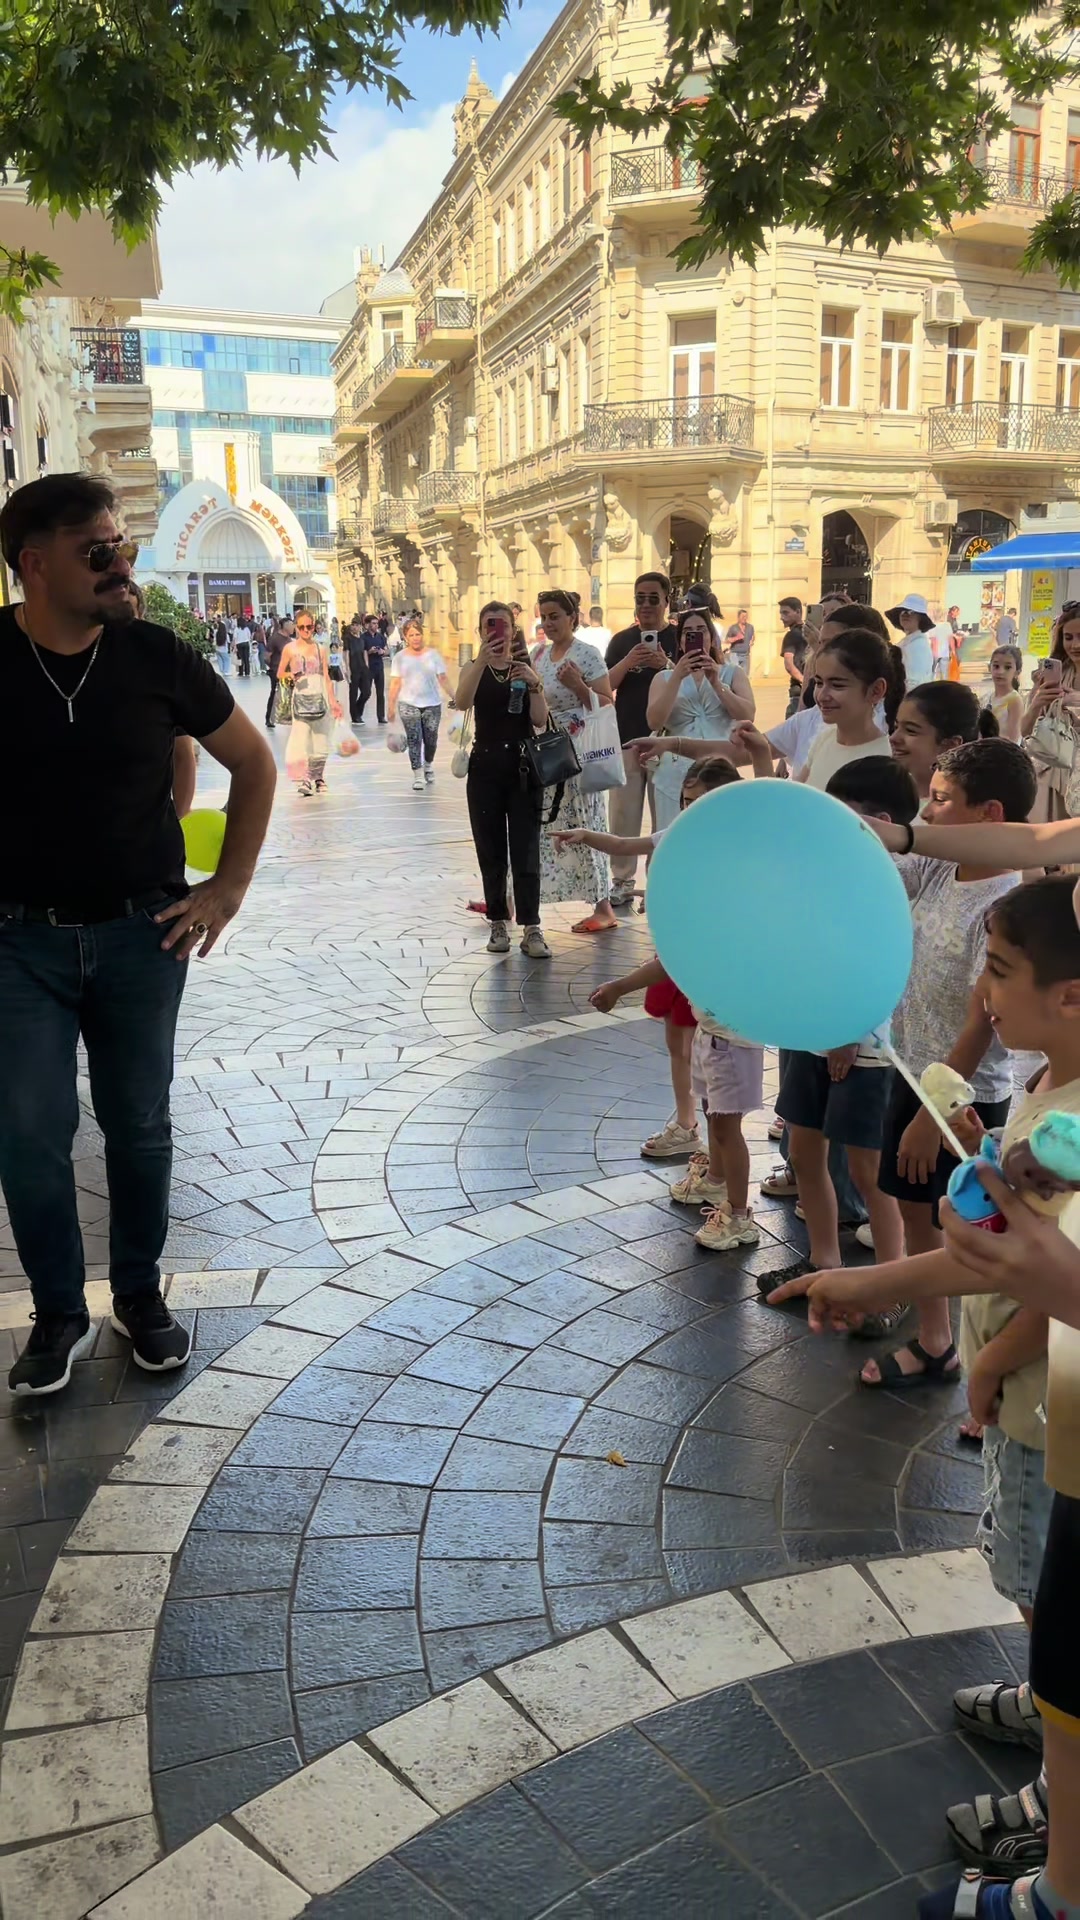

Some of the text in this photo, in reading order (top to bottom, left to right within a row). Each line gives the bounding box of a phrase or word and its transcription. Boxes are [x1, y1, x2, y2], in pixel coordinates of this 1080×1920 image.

[174, 497, 300, 563] TİCARƏT MƏRKƏZİ
[966, 538, 992, 557] TANTUN
